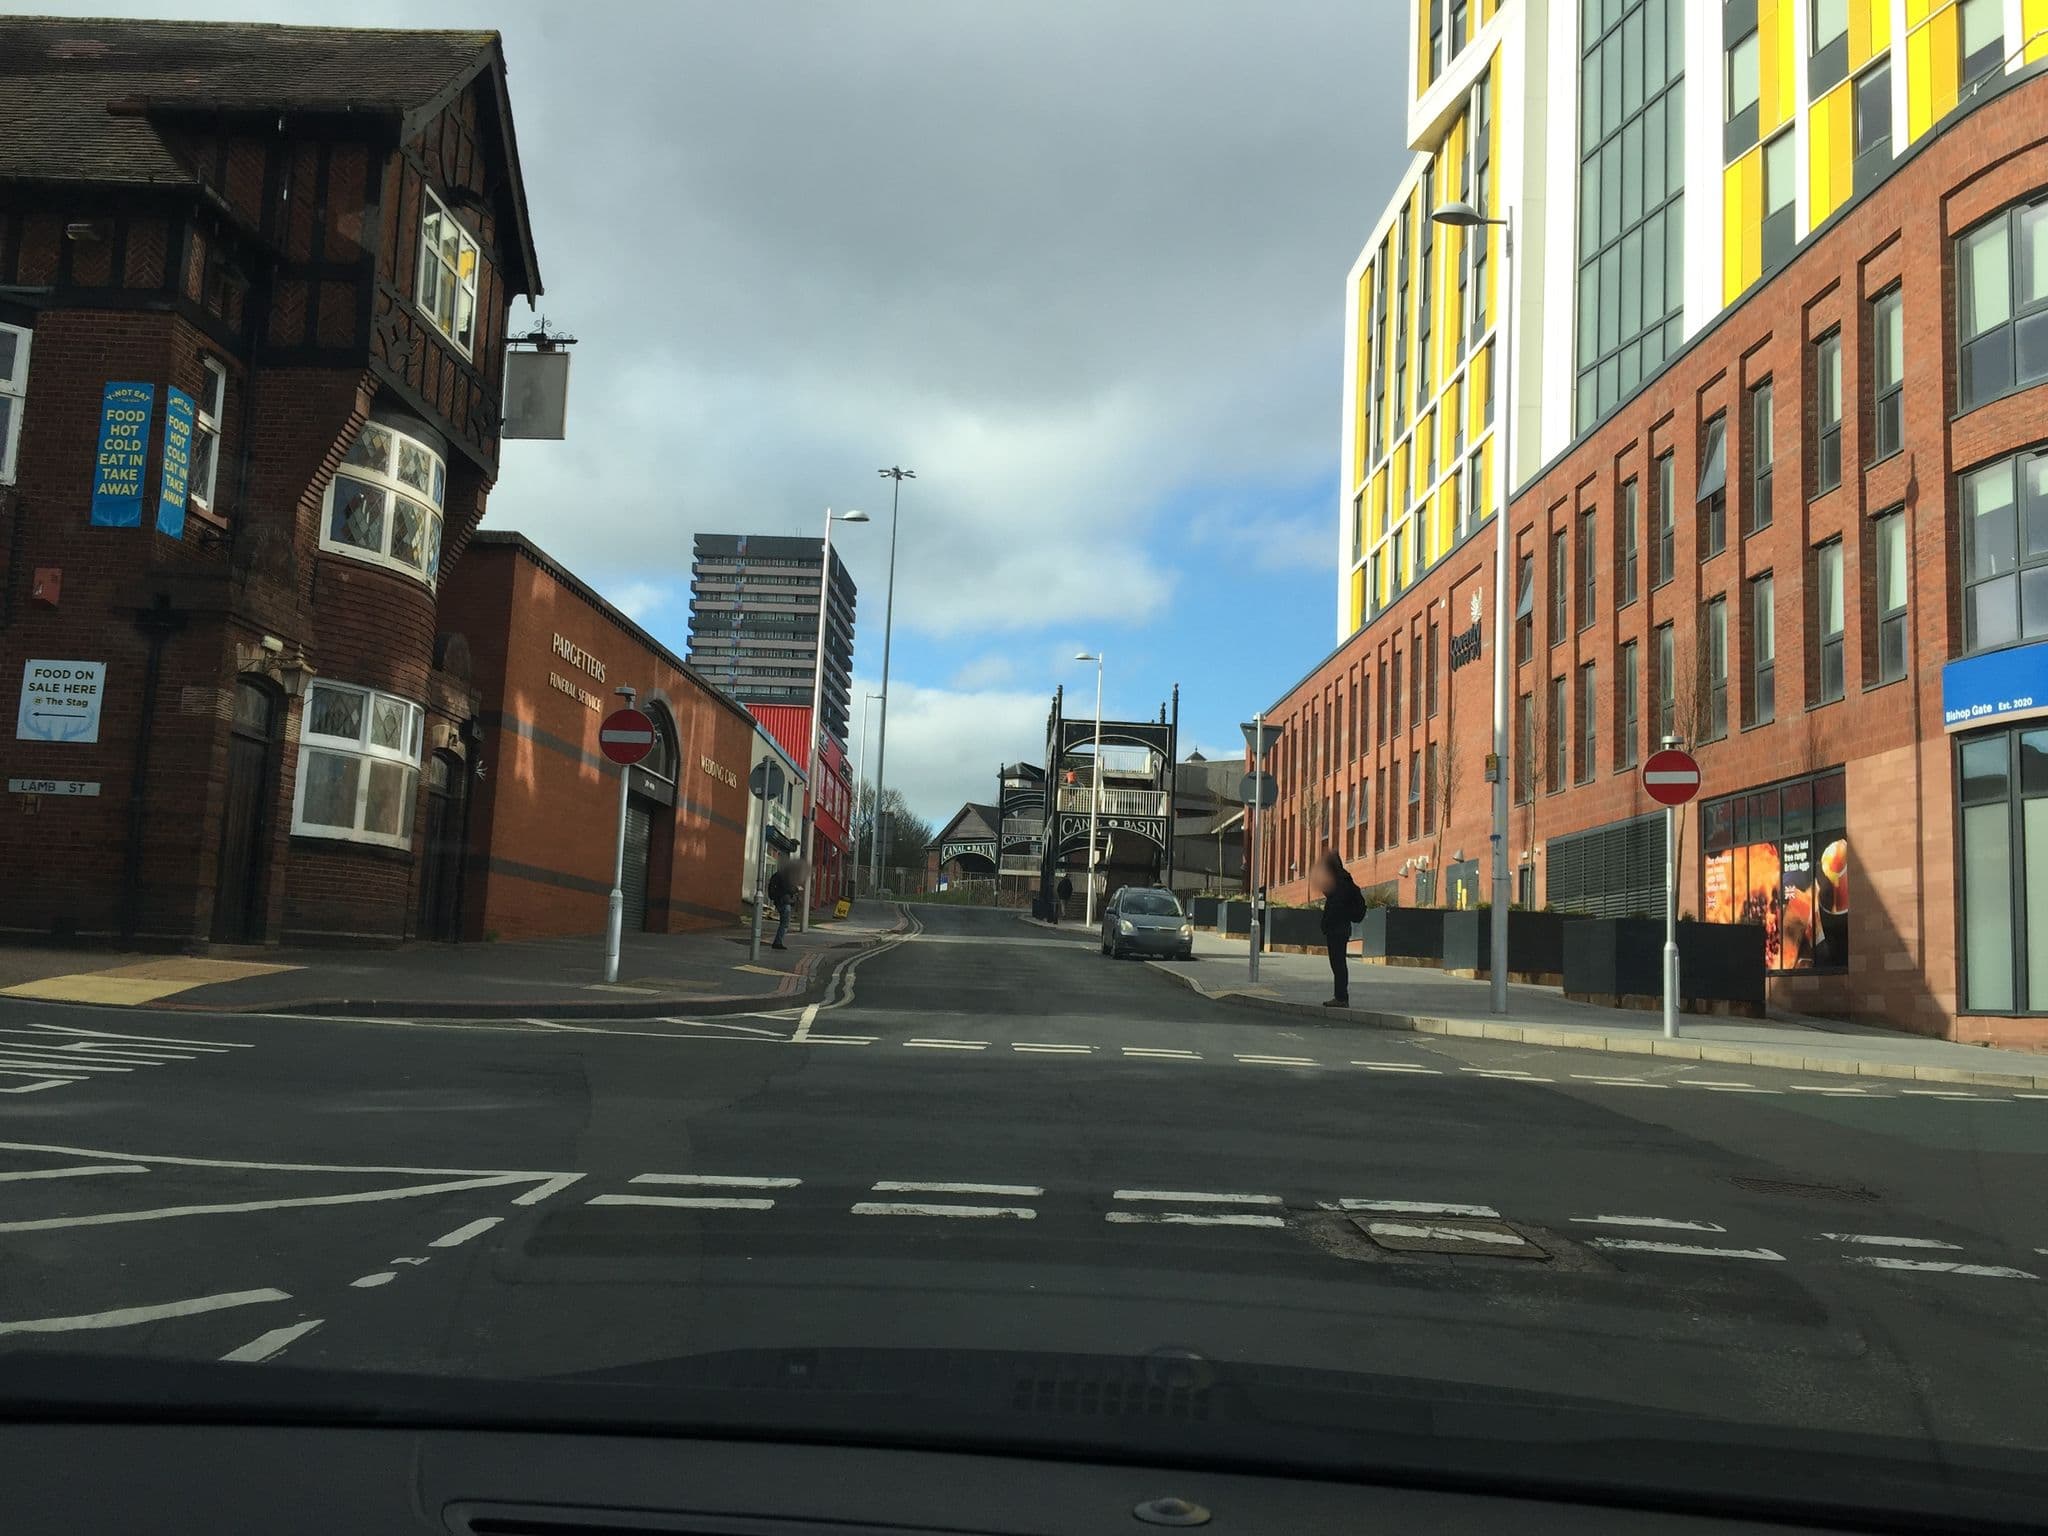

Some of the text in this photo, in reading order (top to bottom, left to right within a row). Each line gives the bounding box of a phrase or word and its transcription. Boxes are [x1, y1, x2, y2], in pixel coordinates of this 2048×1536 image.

[106, 409, 145, 421] FOOD
[110, 425, 139, 436] HOT
[168, 415, 190, 435] FOOD
[104, 439, 141, 451] COLD
[170, 432, 186, 448] HOT
[100, 453, 143, 466] EAT IN
[167, 445, 187, 464] COLD
[102, 468, 137, 481] TAKE
[164, 458, 188, 480] EAT IN
[98, 483, 138, 495] AWAY
[166, 474, 184, 493] TAKE
[163, 489, 184, 508] AWAY
[552, 632, 606, 683] PARGETTERS
[34, 668, 94, 680] FOOD ON
[28, 682, 97, 694] SALE HERE
[549, 671, 601, 713] FUNERAL SERVICE
[45, 697, 63, 706] The
[66, 698, 89, 708] Stag
[1945, 697, 2033, 723] Bishop Gate Est. 2020
[21, 781, 86, 794] LAMB ST
[1062, 818, 1164, 841] CANL BASIN
[943, 844, 995, 860] CANAL BASIN
